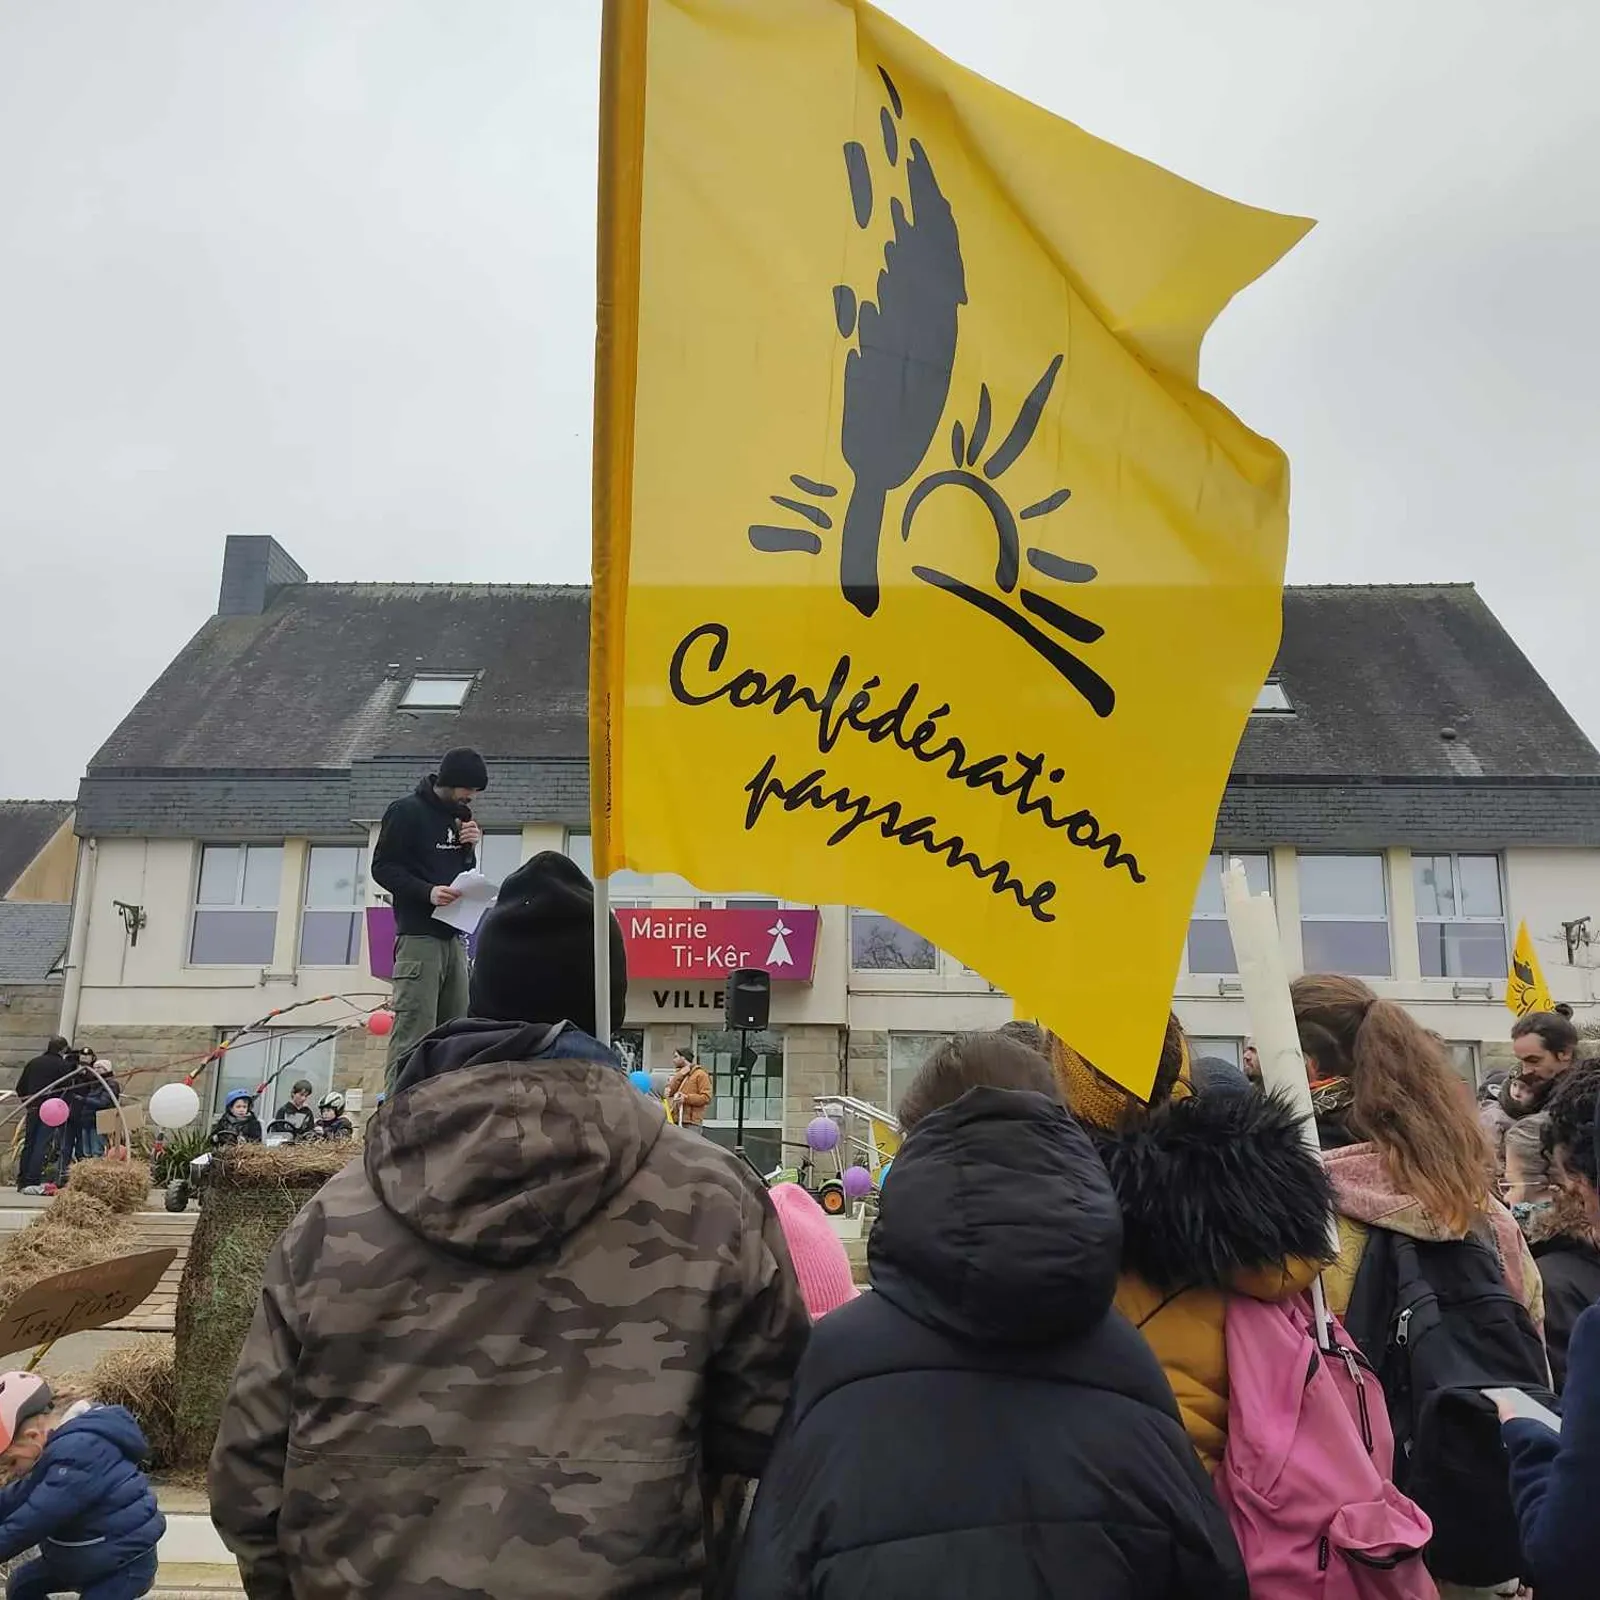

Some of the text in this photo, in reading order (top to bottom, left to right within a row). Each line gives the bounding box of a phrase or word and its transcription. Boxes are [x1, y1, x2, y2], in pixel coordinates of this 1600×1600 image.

[669, 623, 1146, 883] Confédération
[744, 755, 1056, 922] paysanne
[631, 917, 708, 939] Mairie
[671, 945, 751, 968] Ti-Kêr
[653, 990, 725, 1009] VILLE
